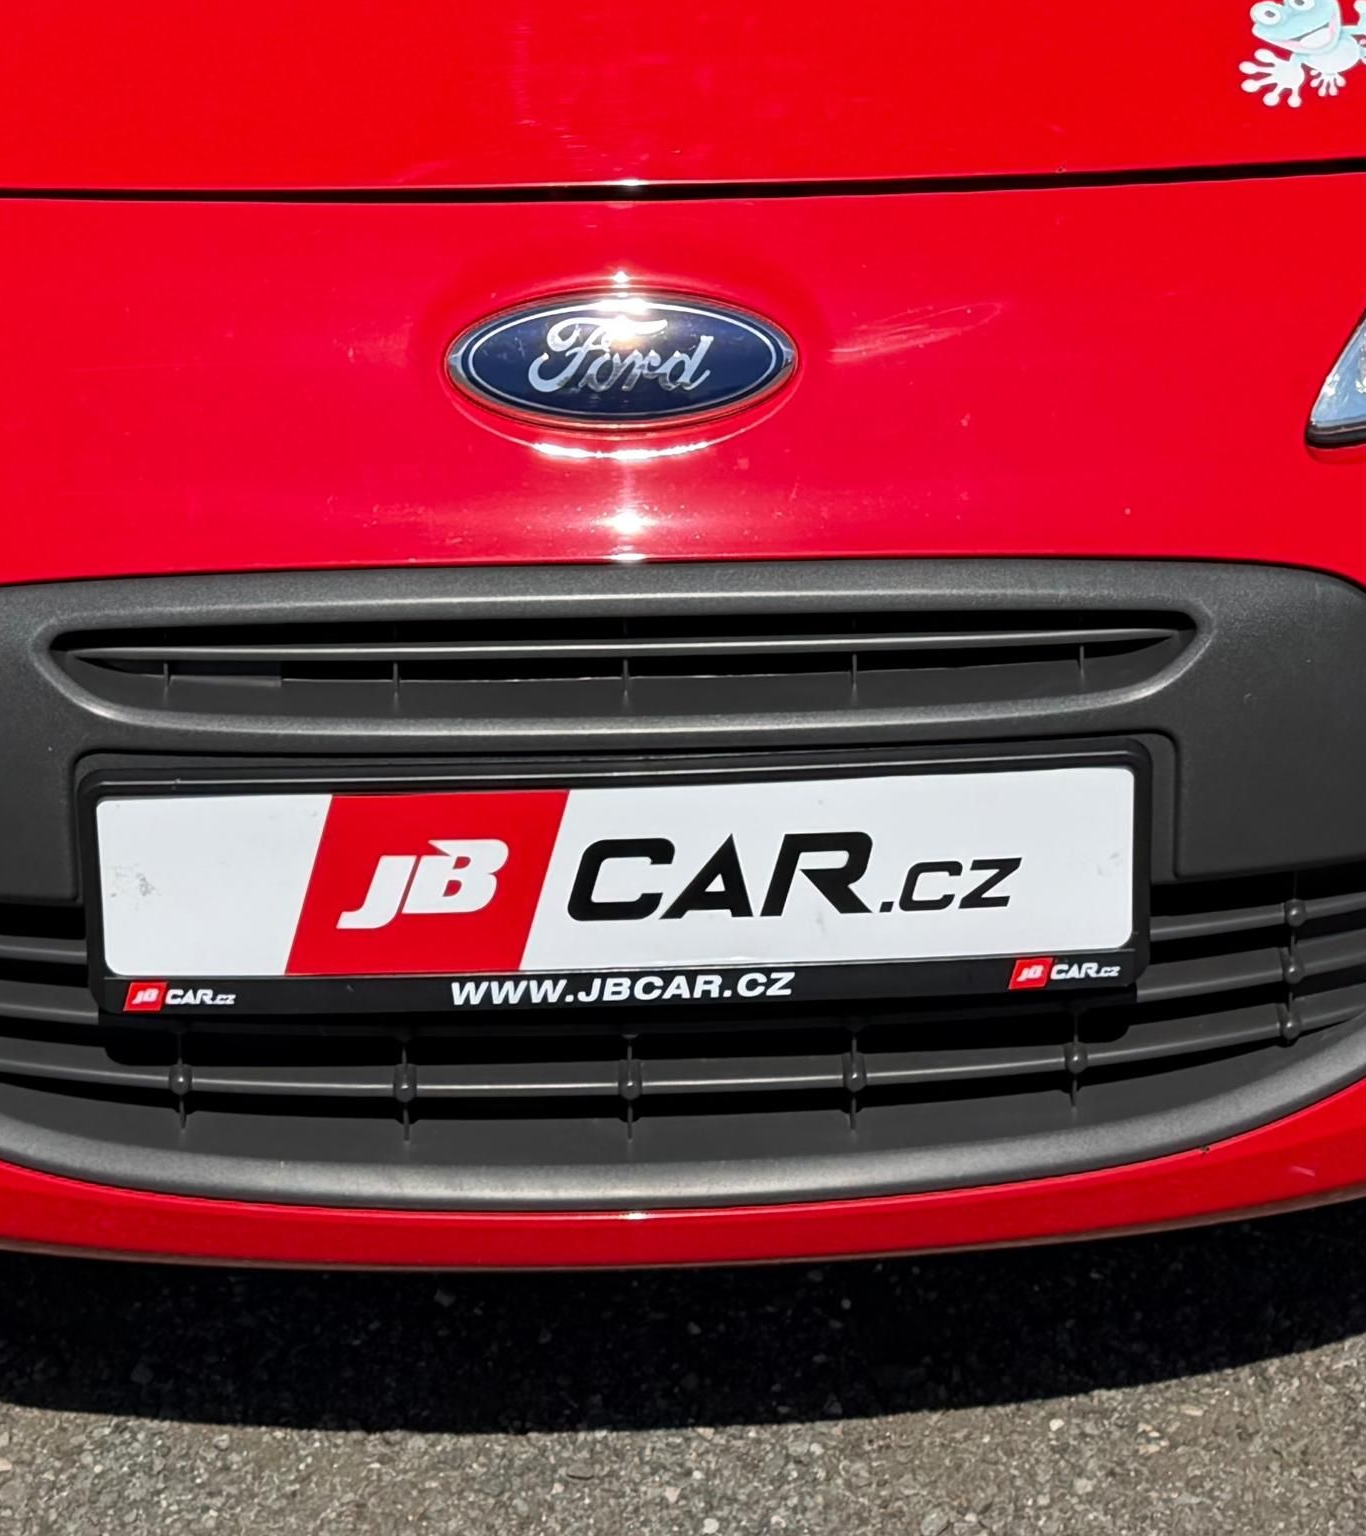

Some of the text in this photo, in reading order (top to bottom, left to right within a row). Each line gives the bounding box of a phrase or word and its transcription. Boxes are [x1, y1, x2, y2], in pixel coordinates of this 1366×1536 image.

[528, 317, 715, 392] Ford
[336, 838, 509, 930] JB
[450, 972, 796, 1006] WWW.JBCAR.CZ
